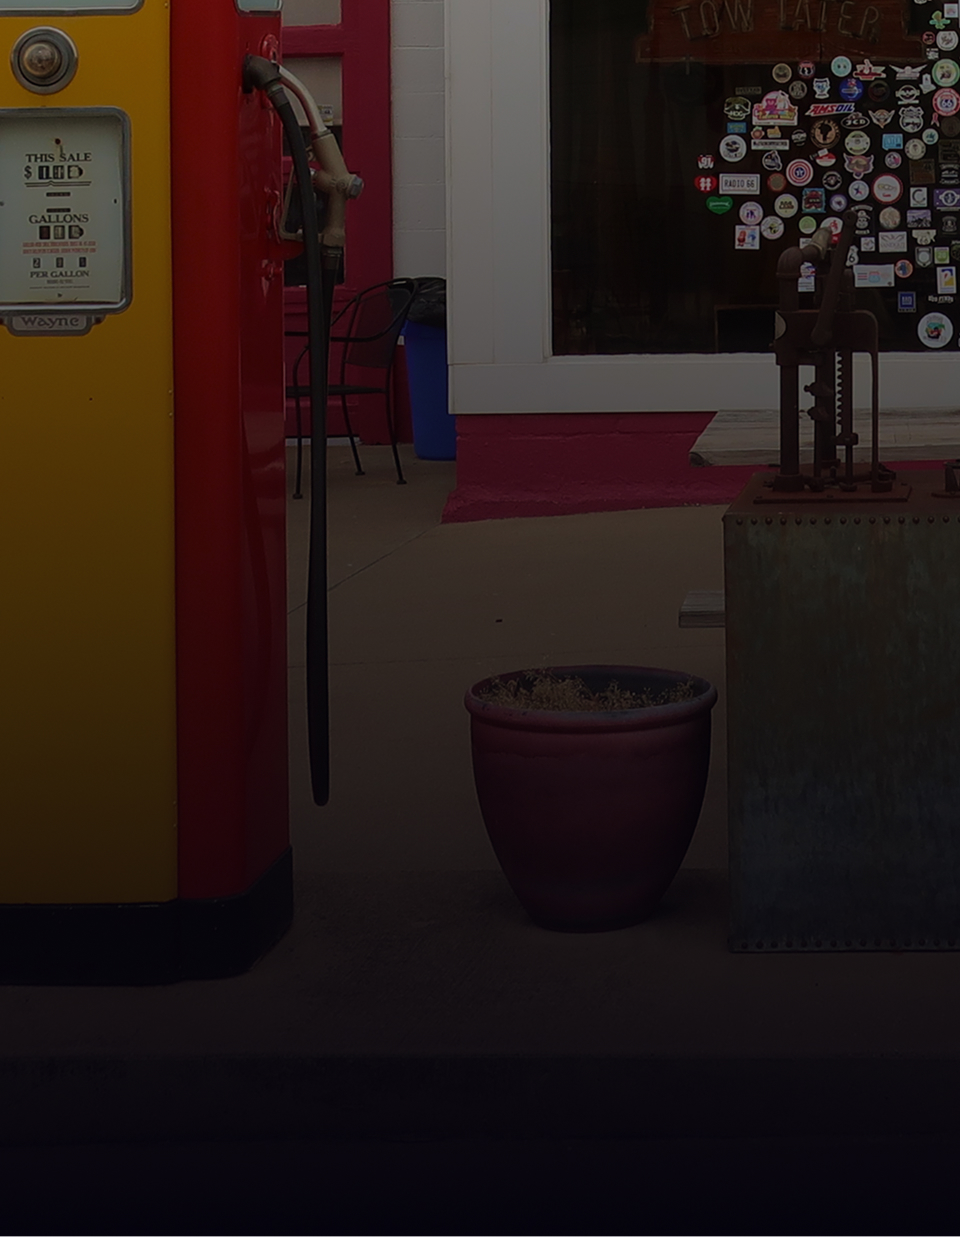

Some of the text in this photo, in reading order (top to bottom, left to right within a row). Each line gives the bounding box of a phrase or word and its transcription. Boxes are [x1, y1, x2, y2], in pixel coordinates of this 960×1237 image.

[810, 104, 855, 115] AMSOIL
[25, 153, 92, 163] THIS SALE
[724, 178, 745, 188] RADIO
[29, 214, 89, 224] GALLONS
[50, 270, 90, 278] GALLON
[21, 316, 80, 330] Wayne
